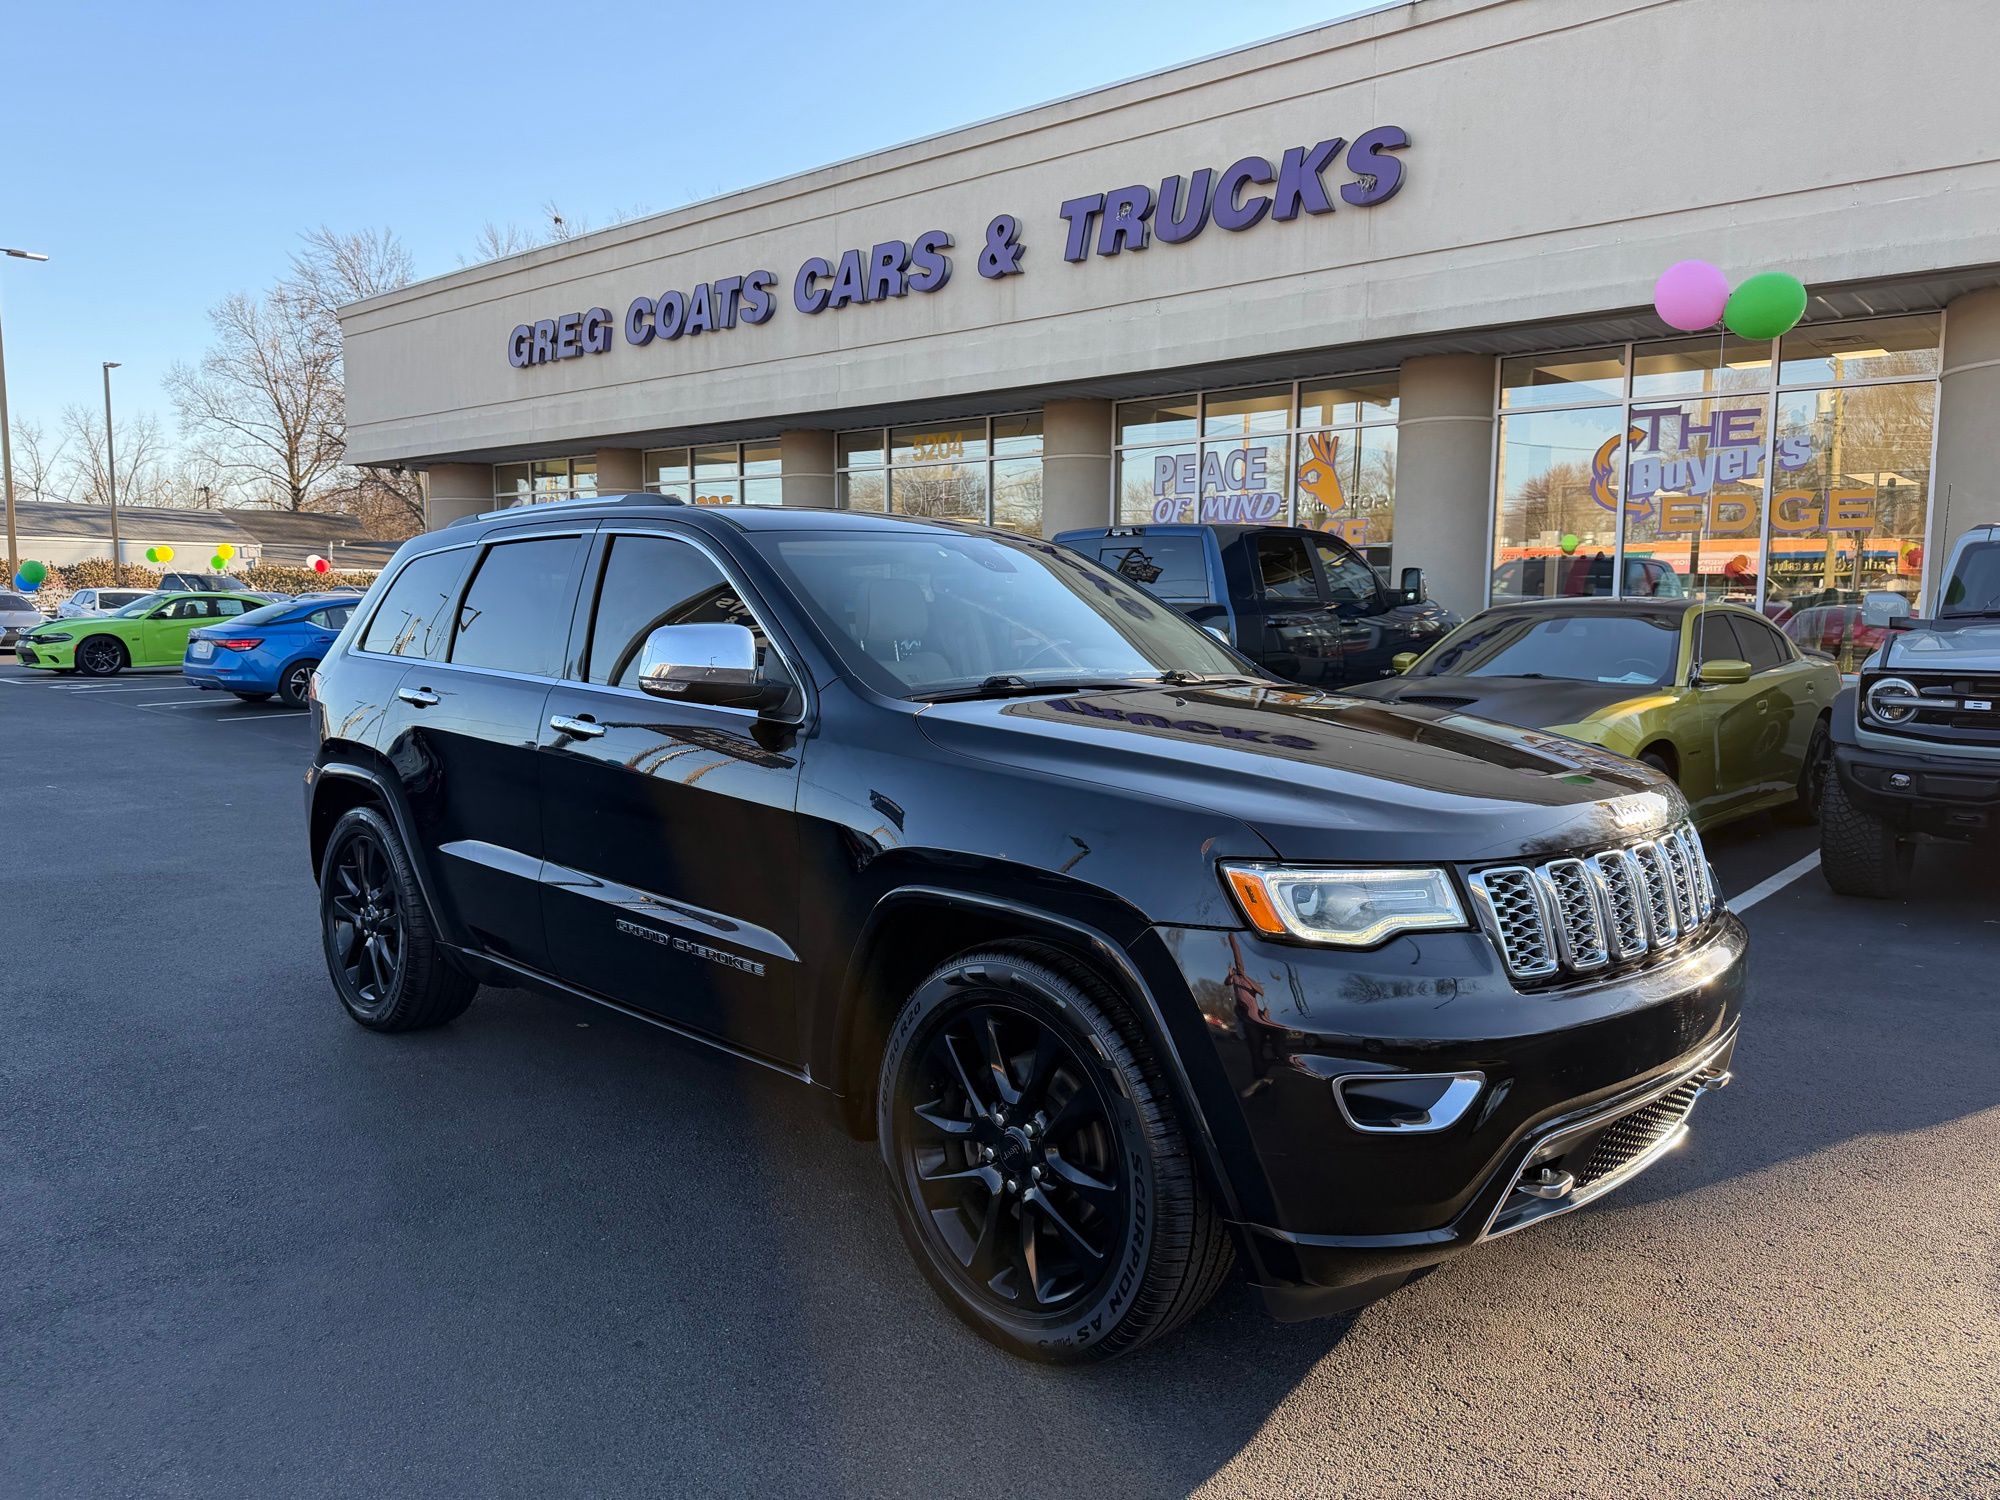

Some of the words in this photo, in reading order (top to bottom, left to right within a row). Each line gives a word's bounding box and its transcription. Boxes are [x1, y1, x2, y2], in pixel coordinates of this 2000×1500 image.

[508, 306, 613, 368] GREG
[625, 269, 778, 346] COATS
[793, 229, 955, 314] CARS
[977, 214, 1025, 279] &
[1059, 125, 1412, 263] TRUCKS
[912, 432, 965, 462] 5204
[1631, 405, 1762, 452] THE
[1154, 446, 1267, 496] PEACE
[1153, 497, 1191, 524] OF
[1200, 492, 1282, 522] MIND
[1657, 488, 1876, 535] EDGE
[616, 918, 670, 945] GRAND
[673, 937, 766, 976] CHEROKEE
[1108, 1151, 1147, 1318] SCORPION
[1076, 1312, 1102, 1344] AS
